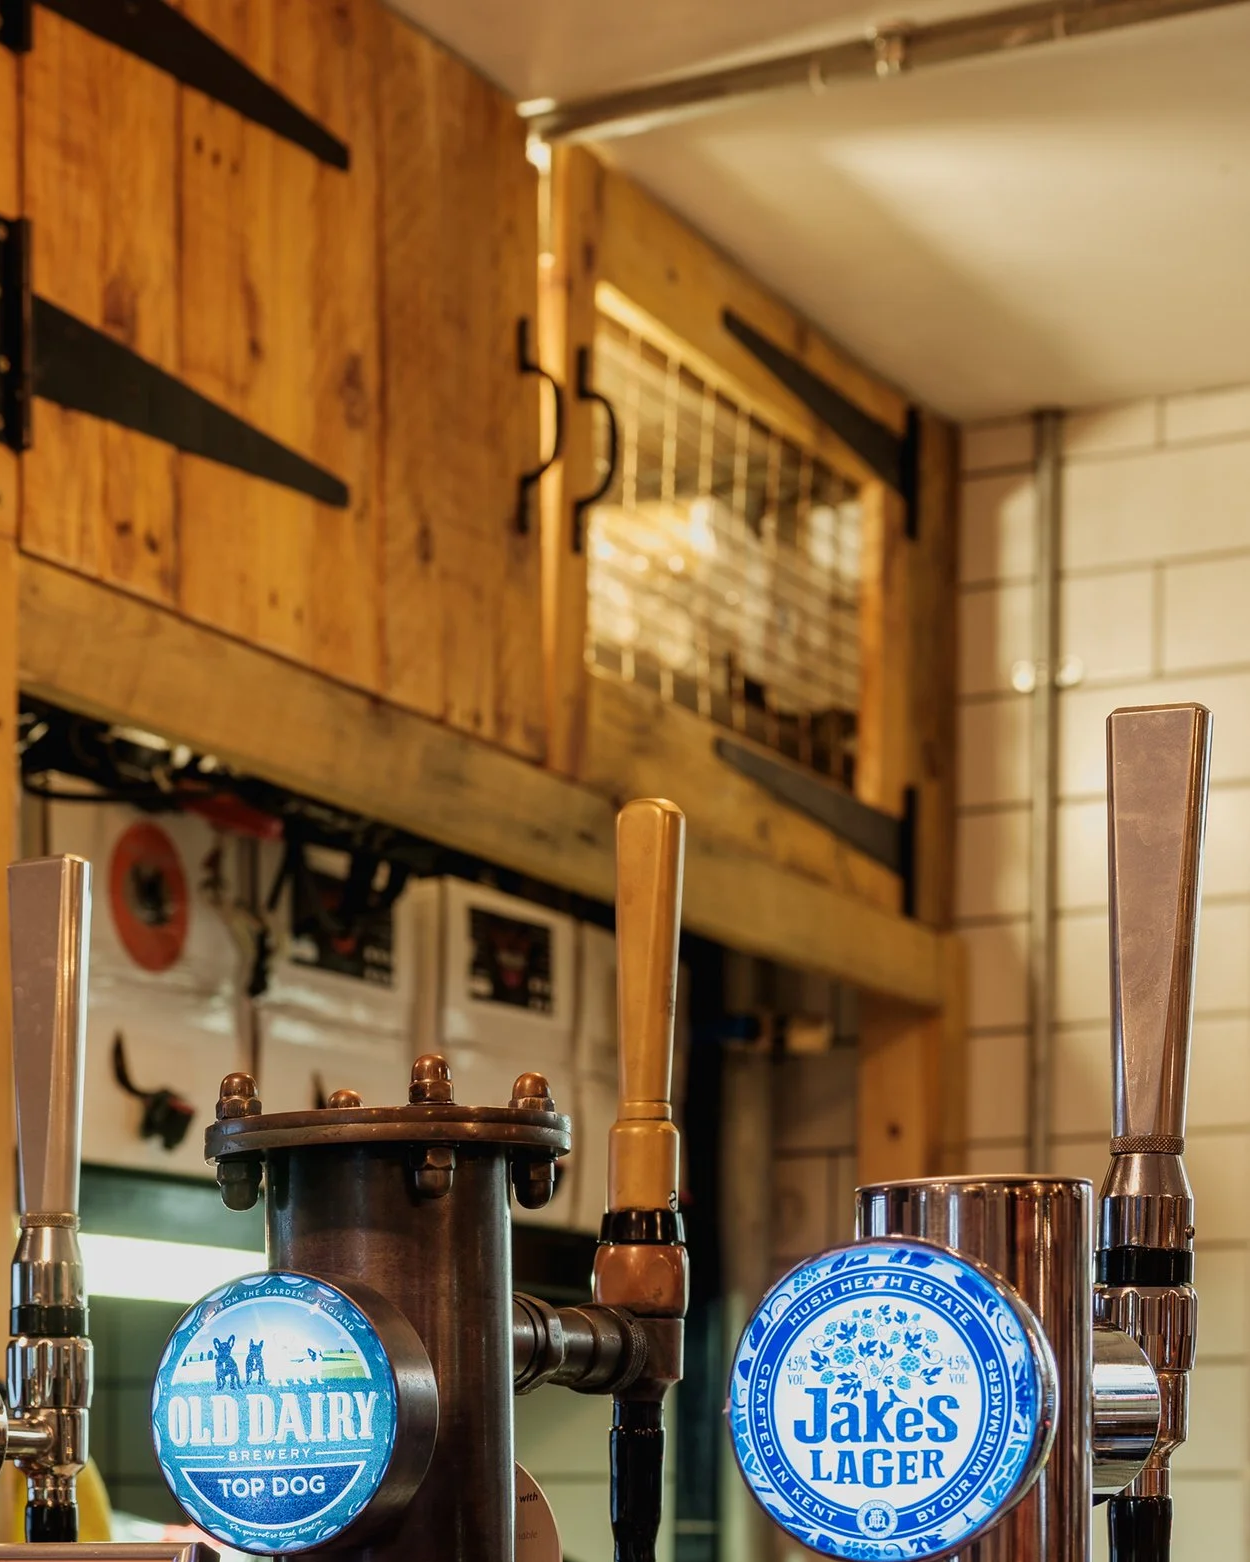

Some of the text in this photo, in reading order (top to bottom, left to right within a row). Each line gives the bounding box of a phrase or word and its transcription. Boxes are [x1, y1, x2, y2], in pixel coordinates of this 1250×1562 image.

[243, 1289, 260, 1298] THE
[265, 1287, 305, 1298] GARDEN
[316, 1299, 355, 1332] ENGLAND
[787, 1275, 972, 1328] HUSH HEATH ESTATE
[787, 1374, 806, 1386] VOL
[948, 1373, 968, 1385] VOL
[167, 1391, 379, 1447] OLD DAIRY
[228, 1449, 310, 1462] BREWERY
[756, 1363, 838, 1523] CRAFTED IN KENT
[916, 1358, 1003, 1523] BY OUR WINEMAKERS
[218, 1475, 326, 1498] TOP DOG
[810, 1448, 945, 1488] LAGER
